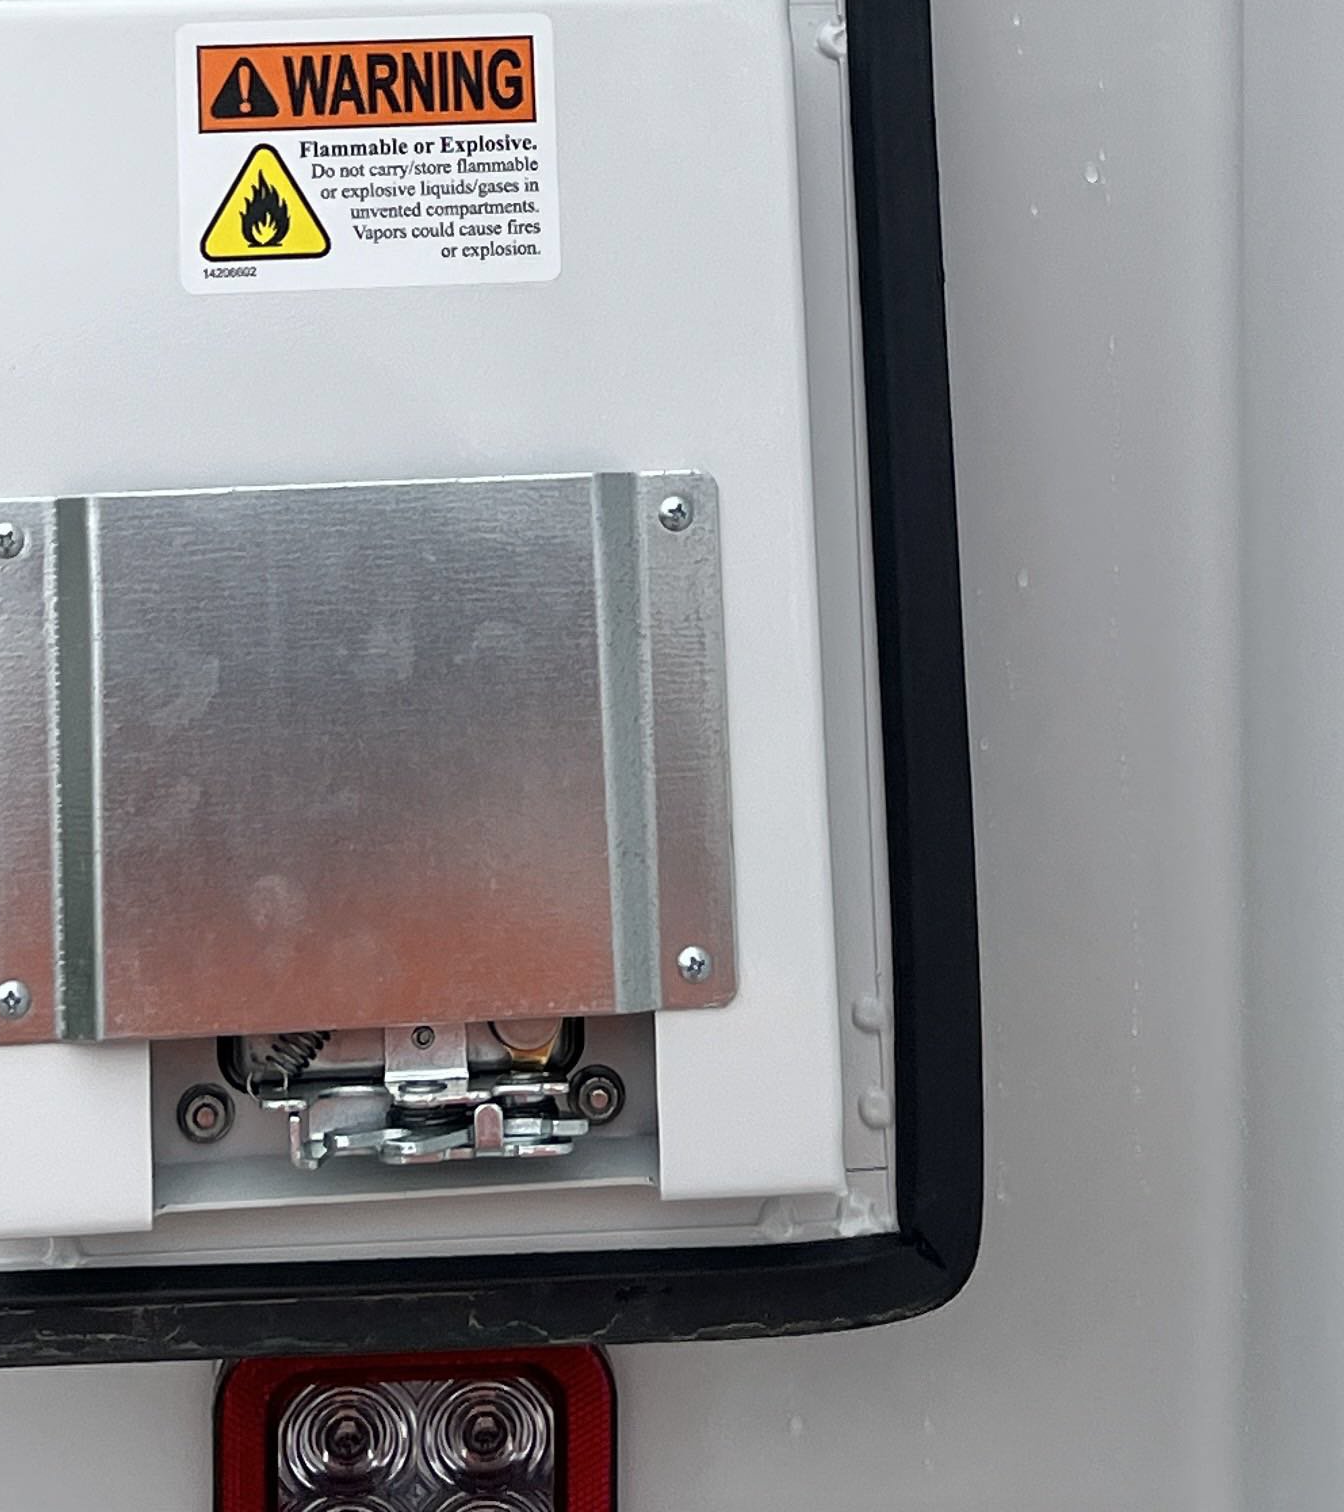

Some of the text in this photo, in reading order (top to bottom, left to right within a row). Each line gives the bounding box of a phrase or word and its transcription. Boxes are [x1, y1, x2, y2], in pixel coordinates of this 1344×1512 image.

[282, 49, 524, 116] WARNING
[299, 134, 537, 158] Flammable or Explosive.
[312, 156, 539, 179] Do not carry/store flammable
[320, 177, 539, 202] or explosive liquids/gases in
[350, 200, 539, 219] unvented compartments.
[352, 219, 541, 244] Vapors could cause fires
[441, 240, 541, 261] or explosion.
